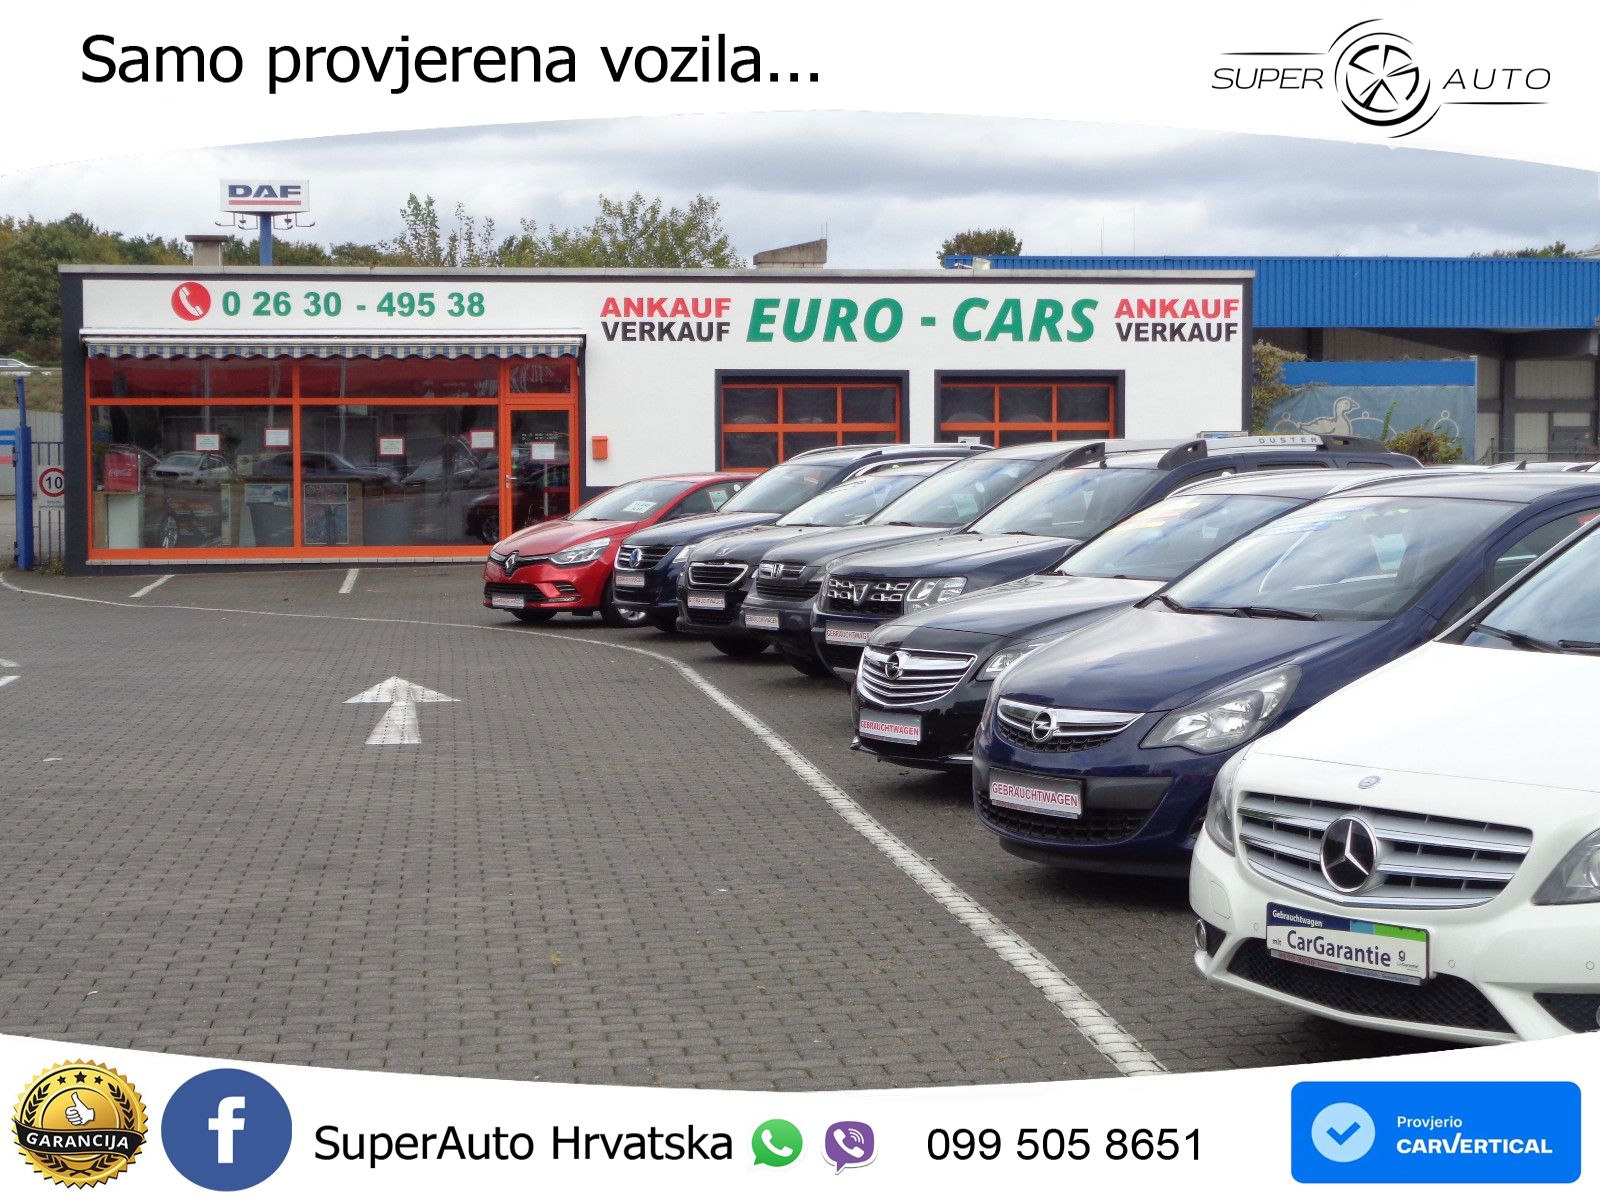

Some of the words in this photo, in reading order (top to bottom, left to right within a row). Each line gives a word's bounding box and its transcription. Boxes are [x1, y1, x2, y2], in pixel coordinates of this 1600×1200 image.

[228, 184, 301, 198] DAF
[222, 291, 241, 317] 0
[252, 291, 292, 317] 26
[303, 291, 342, 317] 30
[377, 292, 436, 318] 495
[447, 292, 485, 318] 38
[599, 296, 732, 318] ANKAUF
[1114, 298, 1240, 319] ANKAUF
[746, 297, 904, 343] EURO
[952, 297, 1099, 343] CARS
[600, 321, 731, 343] VERKAUF
[1115, 322, 1239, 343] VERKAUF
[1258, 437, 1317, 445] DUSTER
[45, 476, 63, 489] 10
[826, 629, 870, 641] GEBRAUCHTWAGE
[860, 720, 920, 737] GEBRAUCHTWAGEN
[992, 782, 1078, 808] GEBRAUCHTWAGEN
[1272, 909, 1323, 928] Gebrauchtwagen
[1272, 938, 1282, 947] mit
[1286, 929, 1392, 968] CarGarantie
